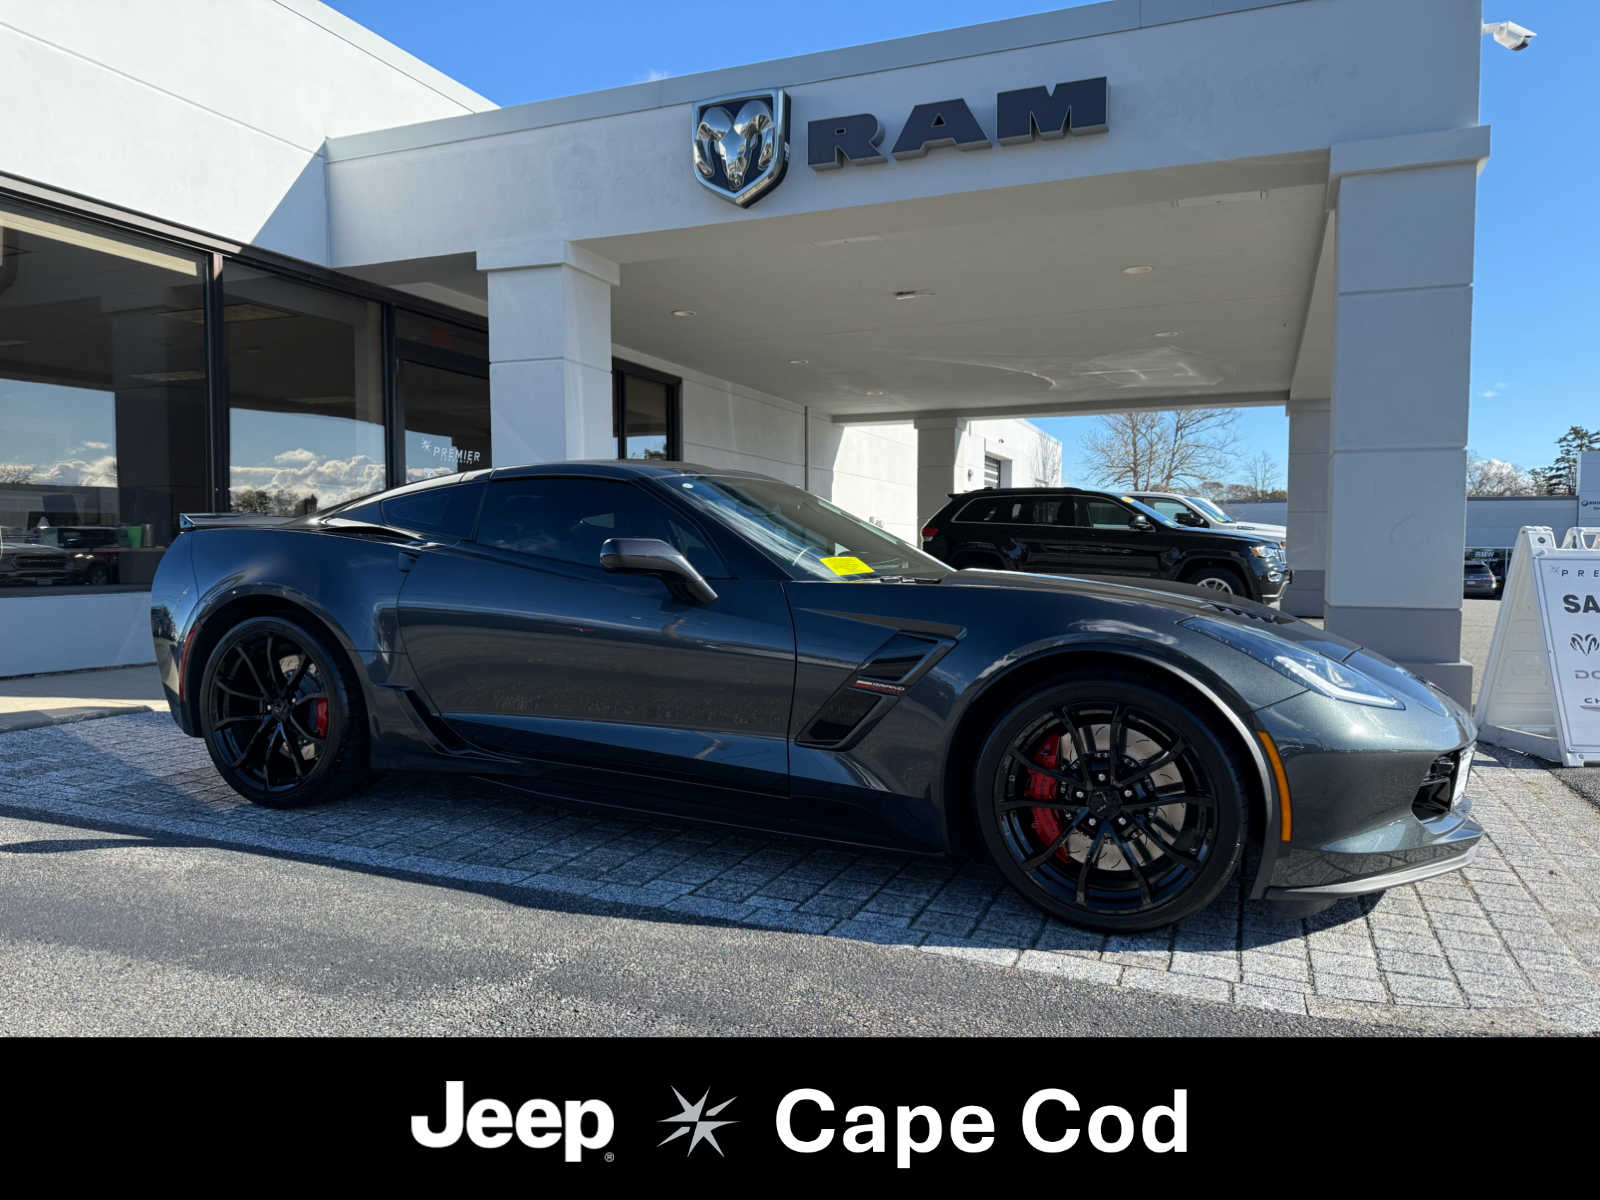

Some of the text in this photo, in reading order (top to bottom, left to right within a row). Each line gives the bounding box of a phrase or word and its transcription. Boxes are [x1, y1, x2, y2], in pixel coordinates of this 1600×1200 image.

[807, 76, 1109, 171] RAM
[433, 446, 480, 462] PREMIER
[1562, 594, 1600, 614] SA
